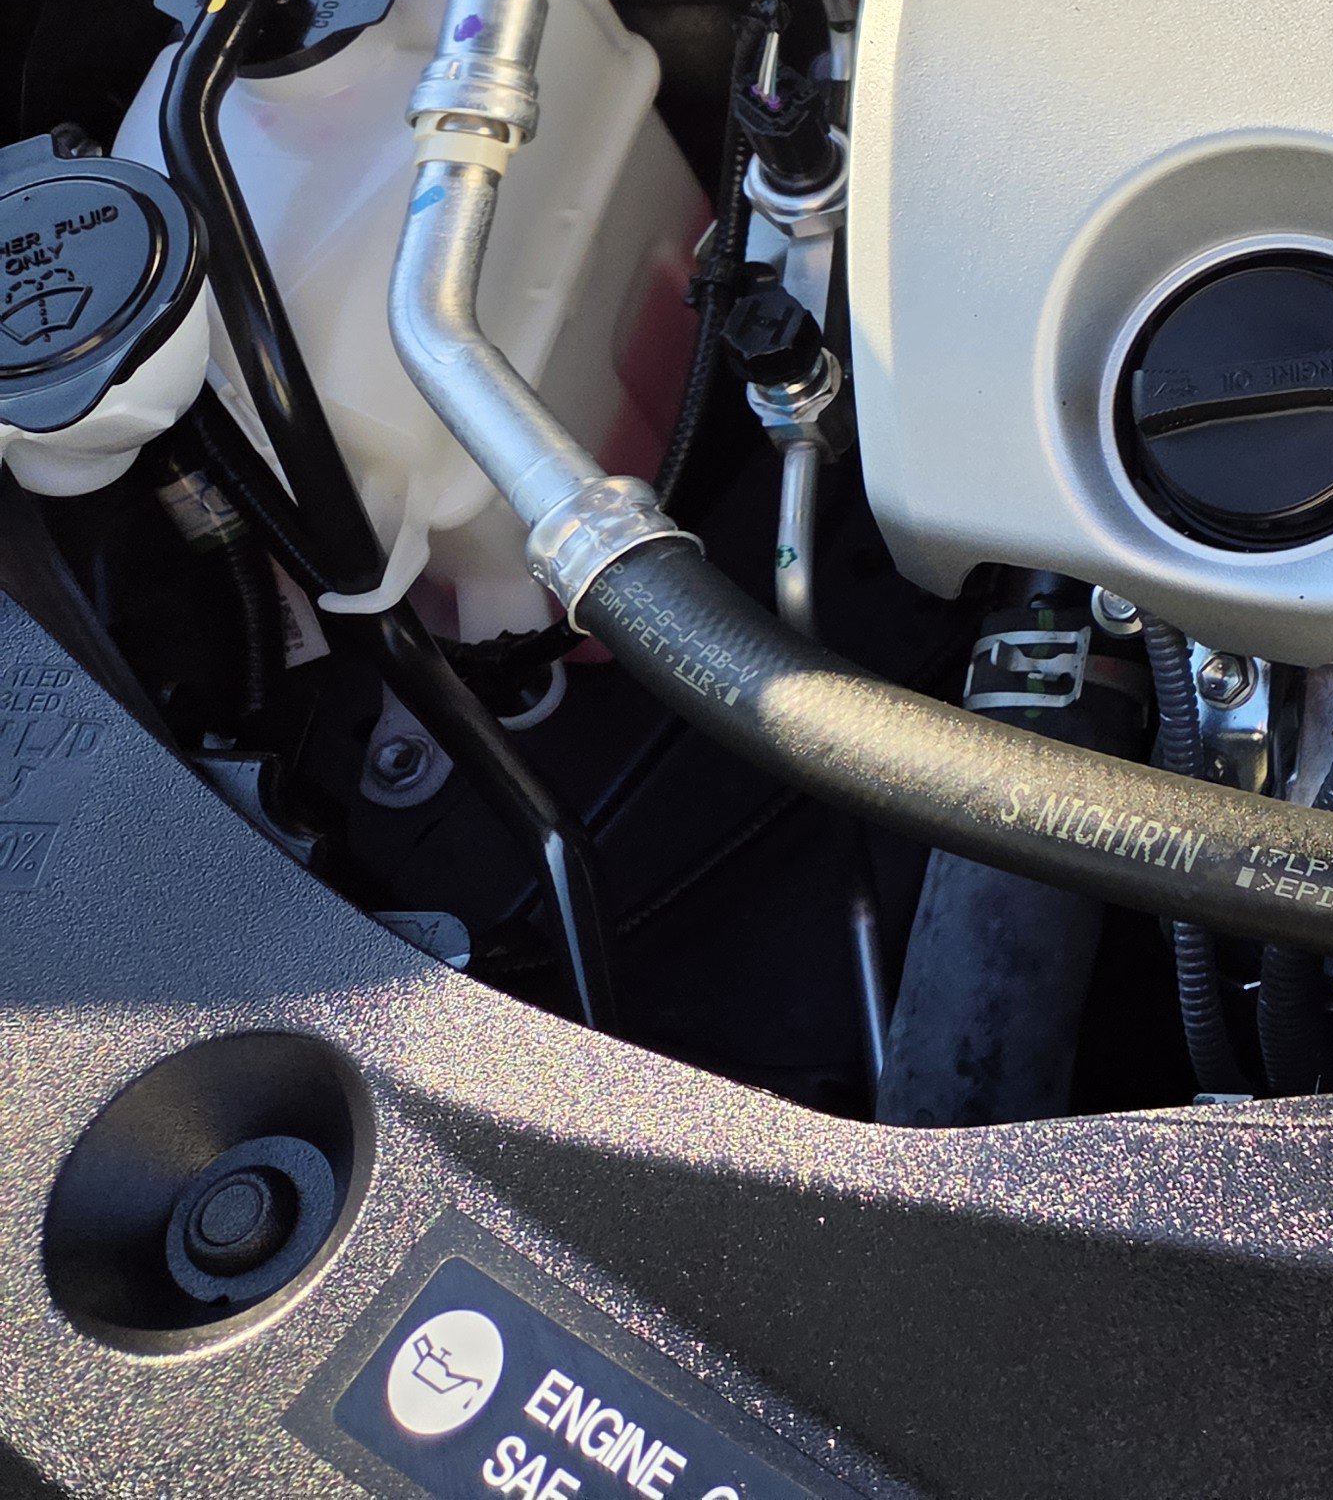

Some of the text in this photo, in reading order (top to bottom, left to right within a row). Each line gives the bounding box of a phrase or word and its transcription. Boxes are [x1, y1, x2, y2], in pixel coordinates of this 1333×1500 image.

[54, 204, 120, 239] FLUID
[5, 242, 65, 276] ONLY
[1033, 792, 1206, 874] NICHIRIN
[523, 1368, 688, 1500] ENGINE
